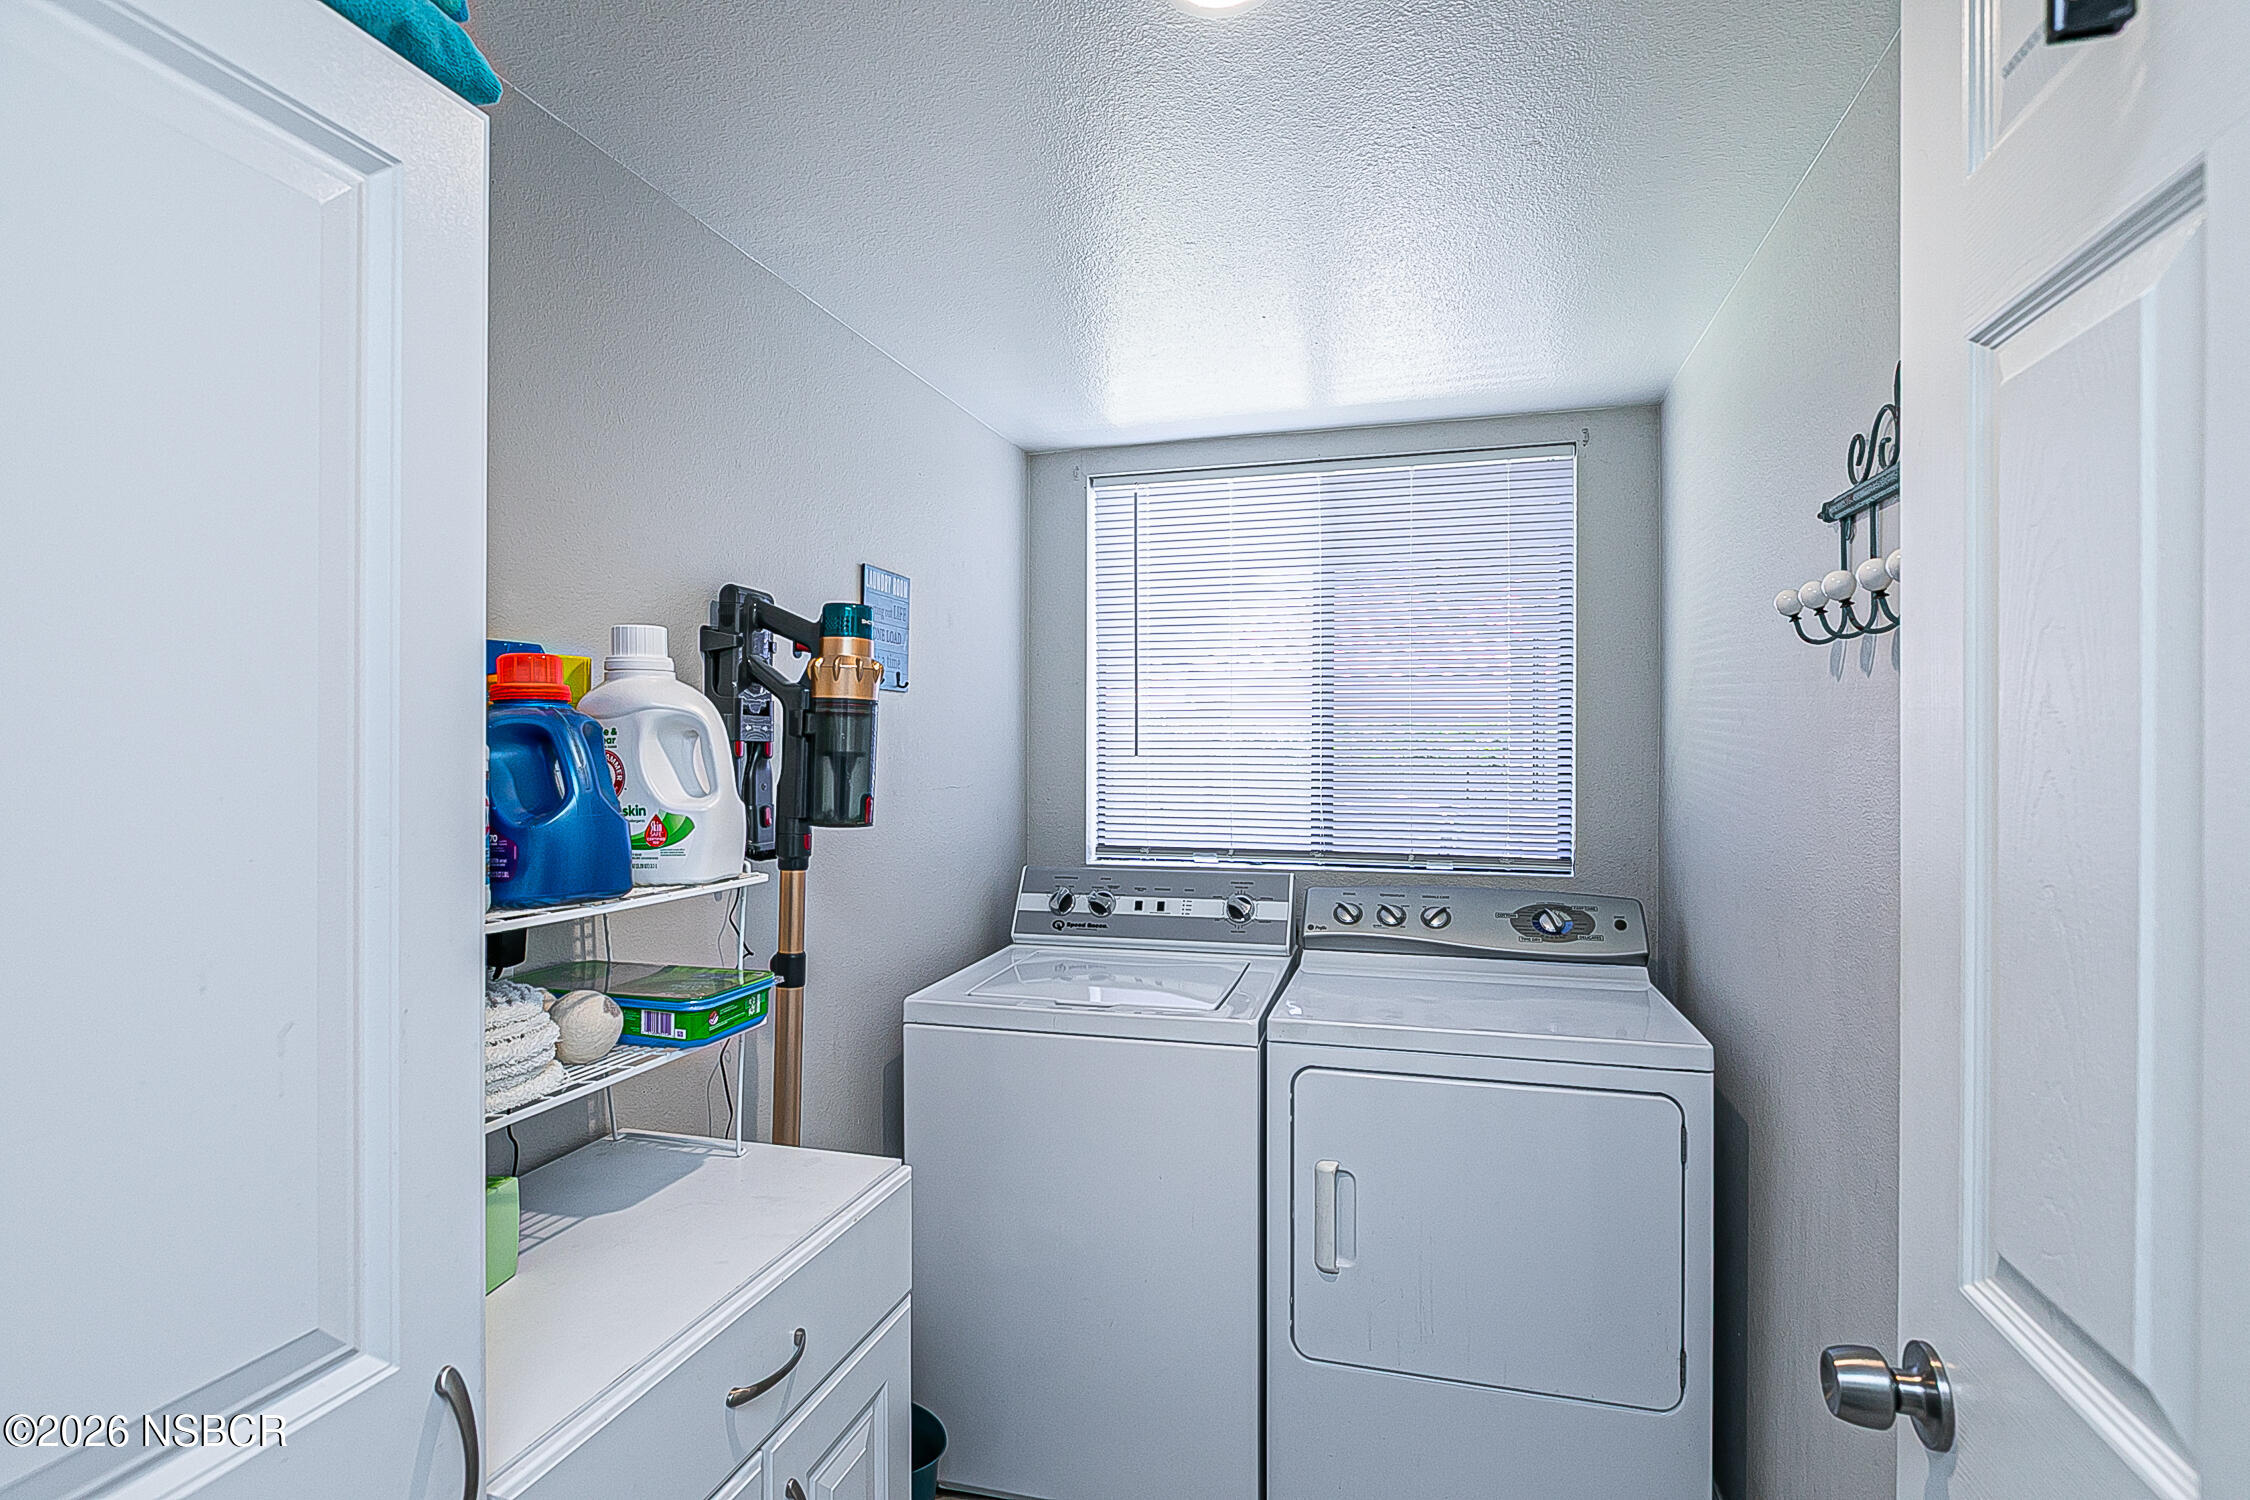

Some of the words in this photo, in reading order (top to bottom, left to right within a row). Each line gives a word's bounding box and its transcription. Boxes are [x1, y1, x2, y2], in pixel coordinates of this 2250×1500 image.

[892, 577, 908, 599] ROOM
[893, 604, 906, 622] LIFE
[886, 630, 901, 644] LOAD
[606, 753, 623, 781] AMMER
[623, 804, 646, 816] skin
